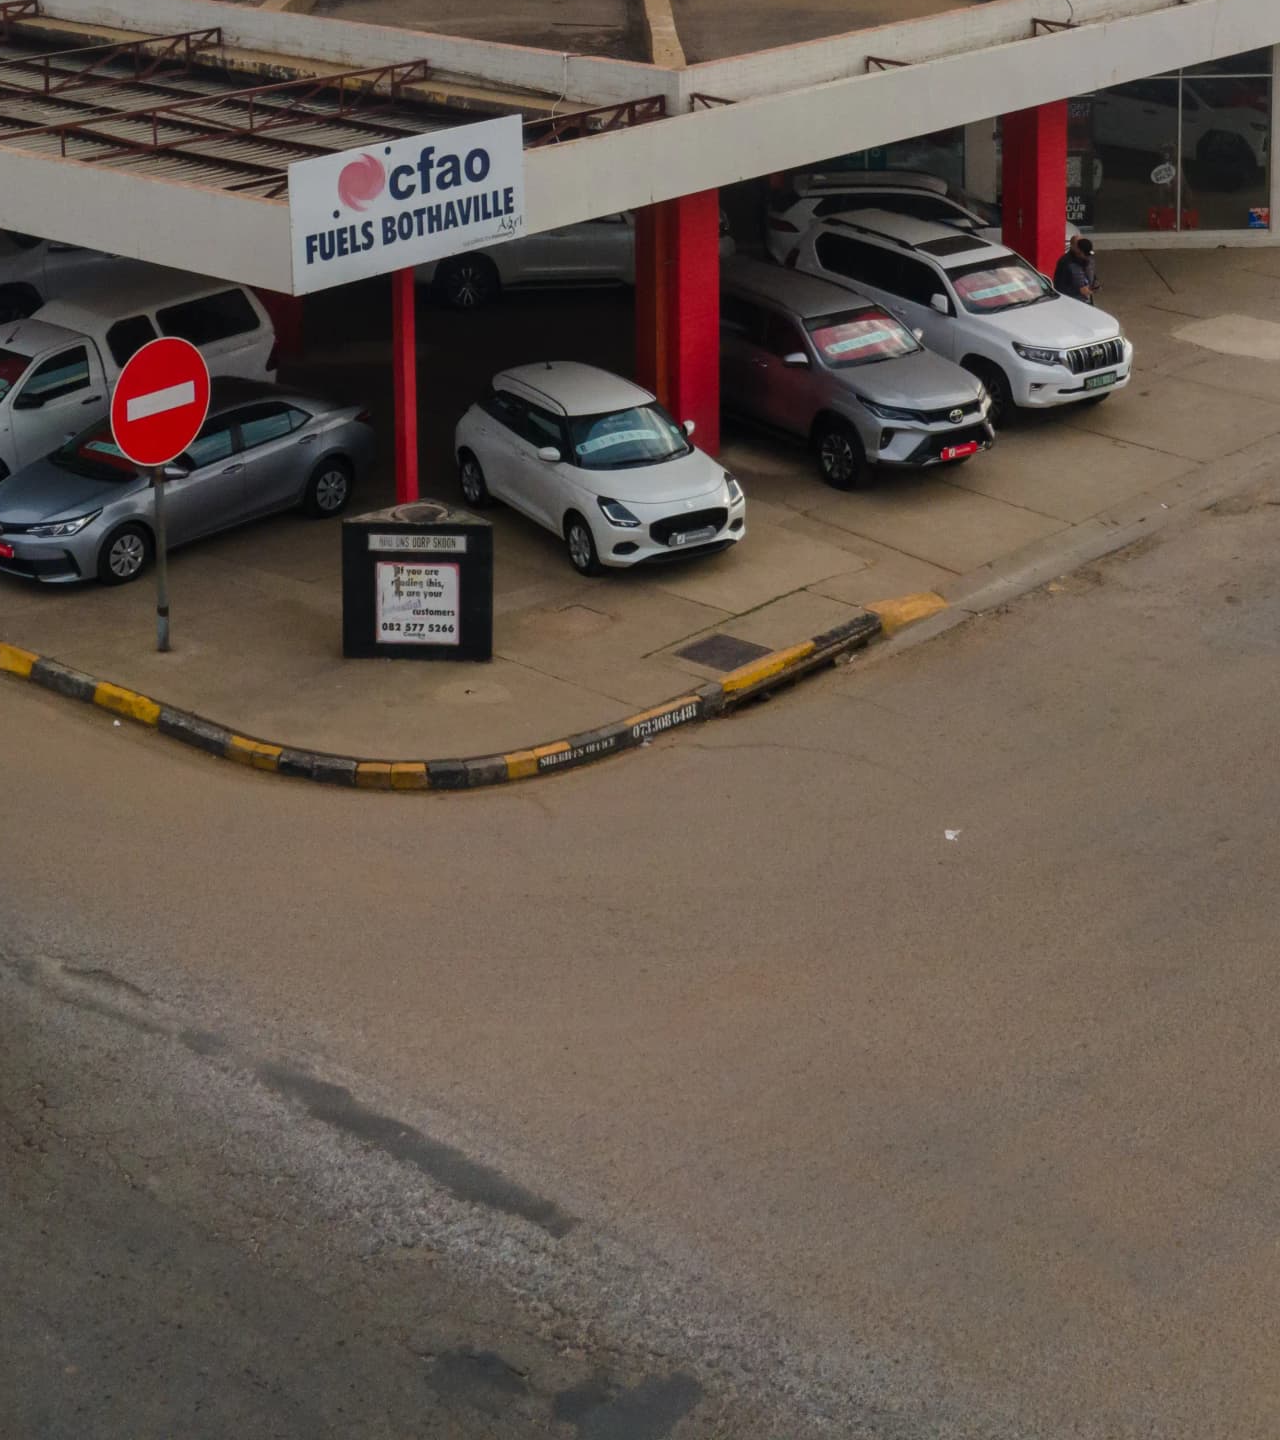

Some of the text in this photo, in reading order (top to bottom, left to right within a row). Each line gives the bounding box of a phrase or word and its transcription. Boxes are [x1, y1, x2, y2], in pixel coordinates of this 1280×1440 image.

[389, 146, 490, 200] cfao
[306, 186, 515, 265] FUELS BOTHAVILLE
[412, 537, 431, 549] DORP
[433, 538, 456, 549] SKOON
[406, 568, 423, 578] you
[424, 569, 440, 577] are
[391, 580, 424, 589] rading
[423, 590, 443, 600] your
[412, 608, 456, 617] customers
[381, 622, 455, 633] 082 577 5266
